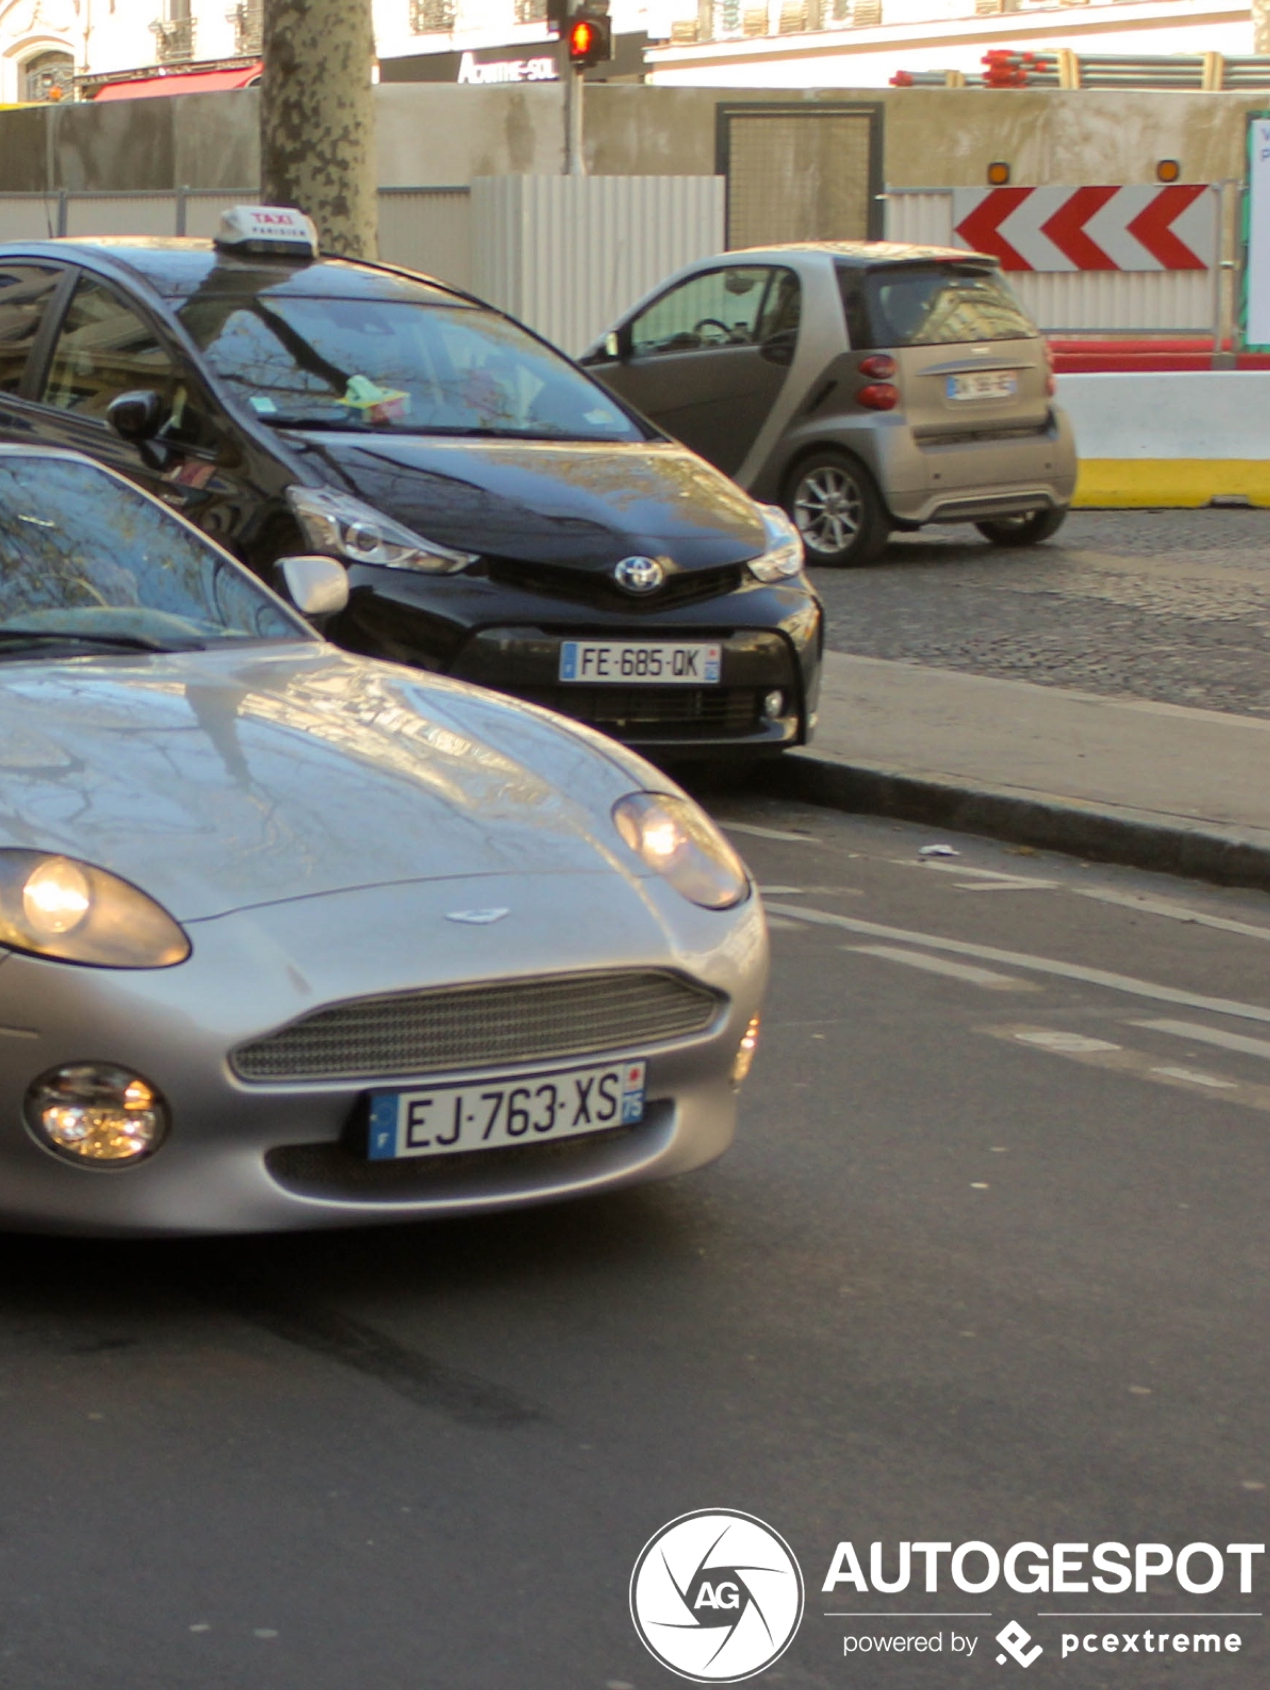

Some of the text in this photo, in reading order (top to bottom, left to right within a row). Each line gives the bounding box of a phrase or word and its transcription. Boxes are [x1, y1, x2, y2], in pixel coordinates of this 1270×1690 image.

[251, 212, 293, 225] TAXI
[582, 648, 698, 676] FE-685-QK
[405, 1073, 619, 1149] EJ-763-XS
[623, 1093, 643, 1118] 75
